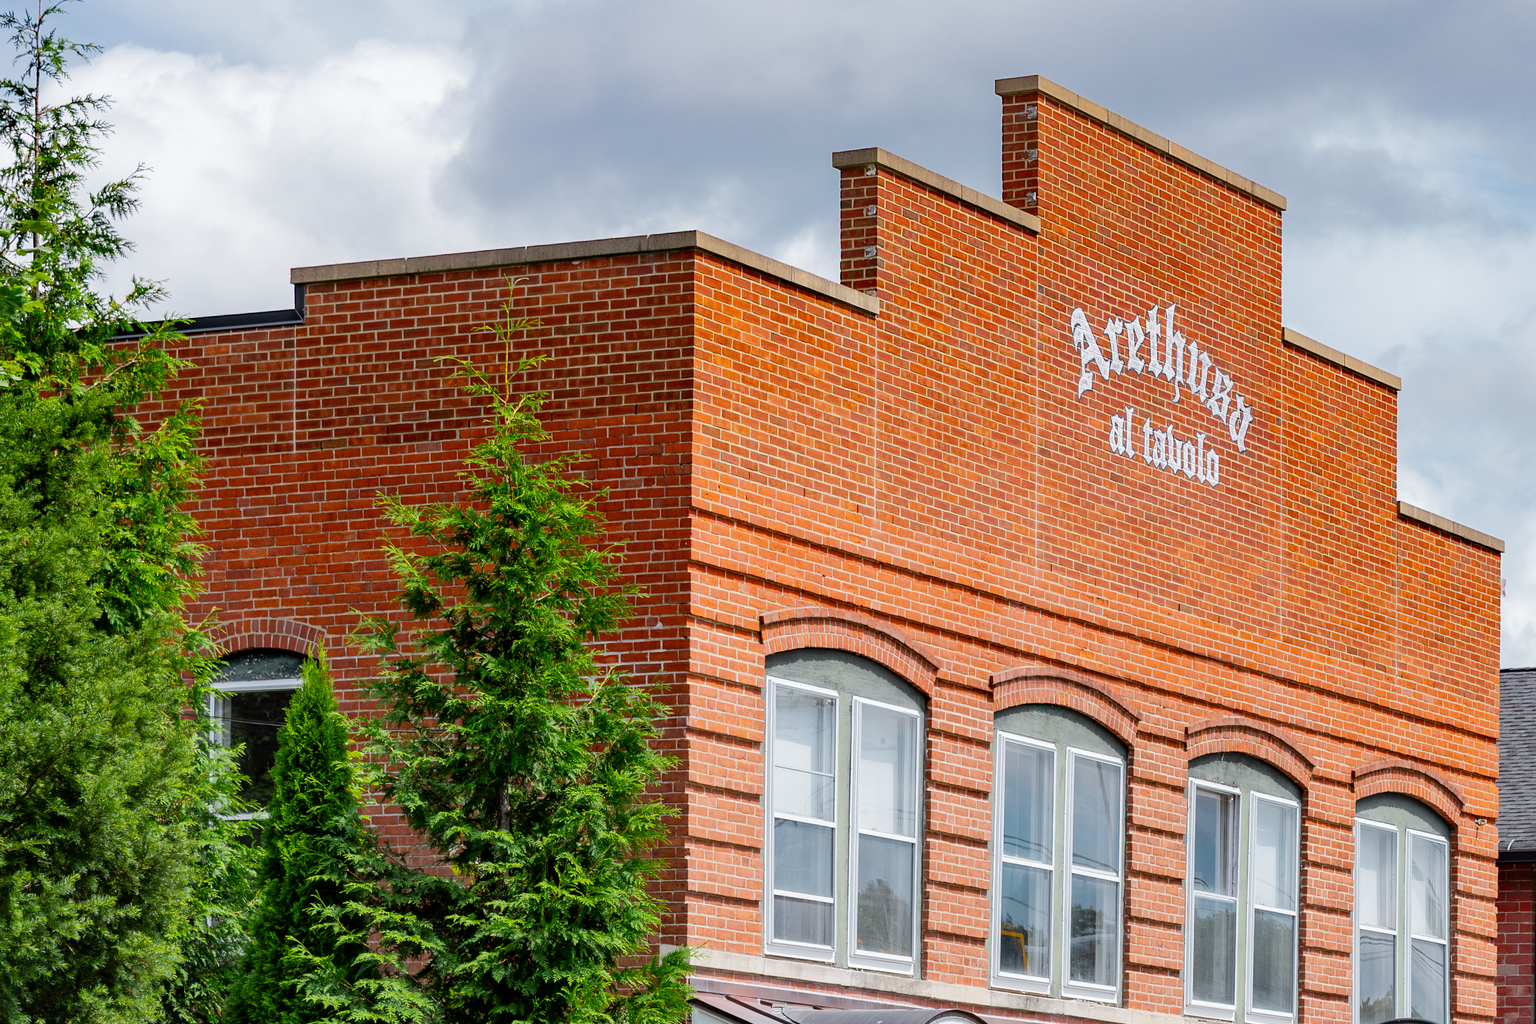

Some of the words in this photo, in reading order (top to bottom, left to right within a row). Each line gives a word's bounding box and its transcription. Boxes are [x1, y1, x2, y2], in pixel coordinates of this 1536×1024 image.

[1070, 301, 1254, 454] Arethusa
[1109, 403, 1136, 460] al
[1142, 416, 1220, 488] tavolo
